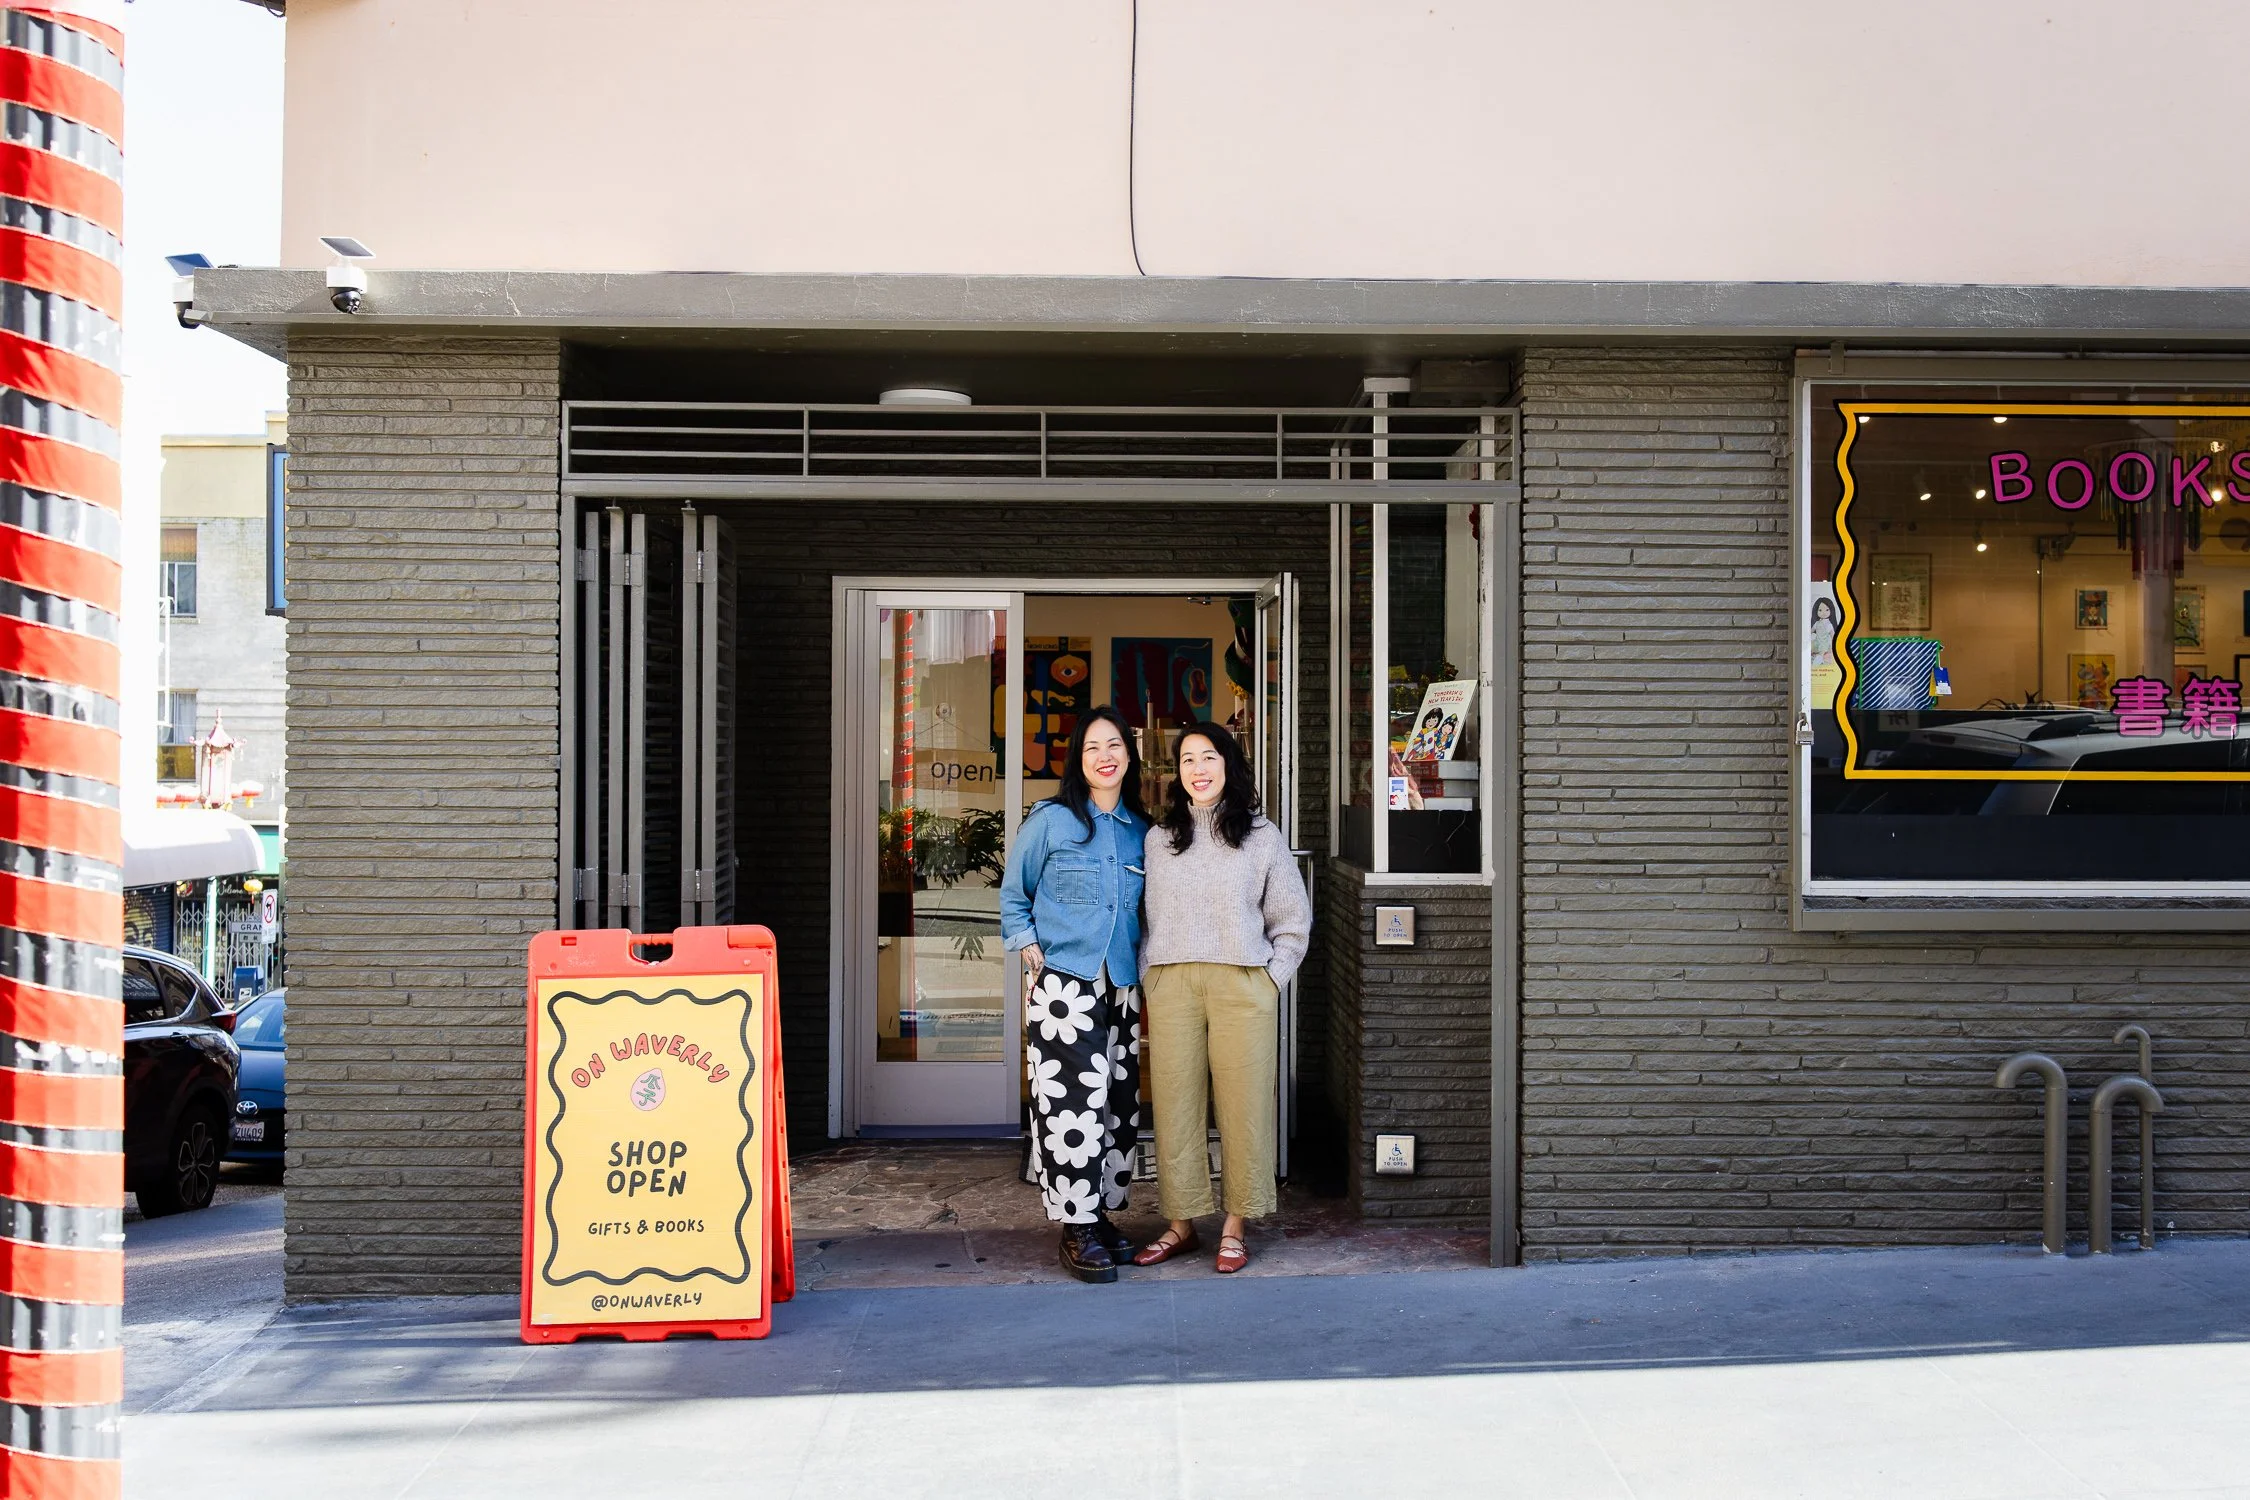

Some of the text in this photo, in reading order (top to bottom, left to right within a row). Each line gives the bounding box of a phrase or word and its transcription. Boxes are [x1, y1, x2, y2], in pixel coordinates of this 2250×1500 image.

[1989, 450, 2250, 511] BOOKS
[2111, 675, 2243, 738] 書籍
[931, 761, 993, 785] open
[240, 923, 263, 931] GRAN
[571, 1033, 730, 1088] ON WAVERLY
[608, 1140, 687, 1168] SHOP
[606, 1168, 687, 1197] OPEN
[588, 1219, 705, 1236] GIFTS & BOOKS
[591, 1292, 702, 1311] @ONWAVERLY
